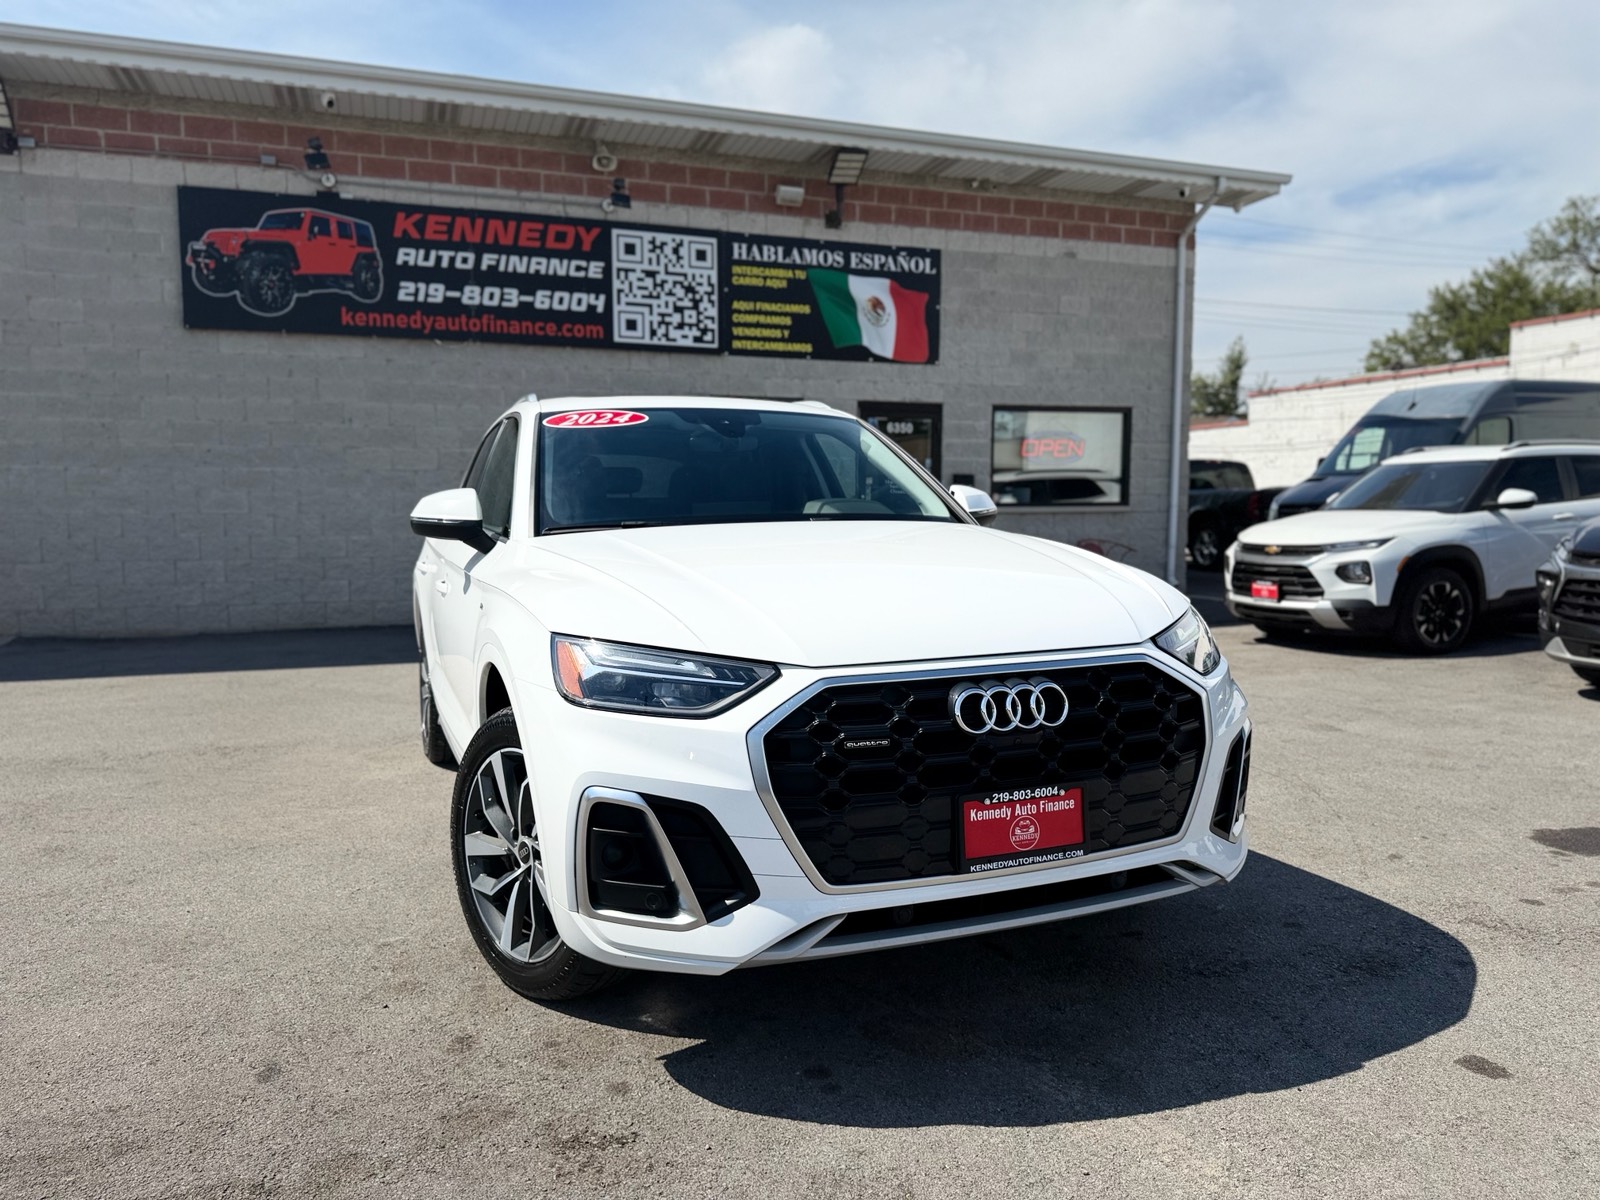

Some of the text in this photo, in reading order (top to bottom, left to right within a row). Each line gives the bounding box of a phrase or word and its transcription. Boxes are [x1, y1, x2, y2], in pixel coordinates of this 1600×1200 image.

[393, 212, 602, 251] KENNEDY
[396, 247, 606, 280] AUTO FINANCE
[732, 242, 937, 275] HABLAMOS ESPAÑOL
[731, 275, 765, 287] CARRO
[397, 281, 606, 314] 219-803-6004
[340, 306, 605, 339] kennedyautofinance.com
[731, 313, 792, 326] COMPRAMOS
[559, 412, 633, 426] 2024
[1020, 438, 1086, 458] OPEN
[846, 740, 889, 748] quattro
[992, 786, 1059, 803] 219-803-6004
[970, 799, 1075, 822] Kennedy Auto Finance
[970, 849, 1084, 872] KENNEDYAUTOFINANCE.COM
